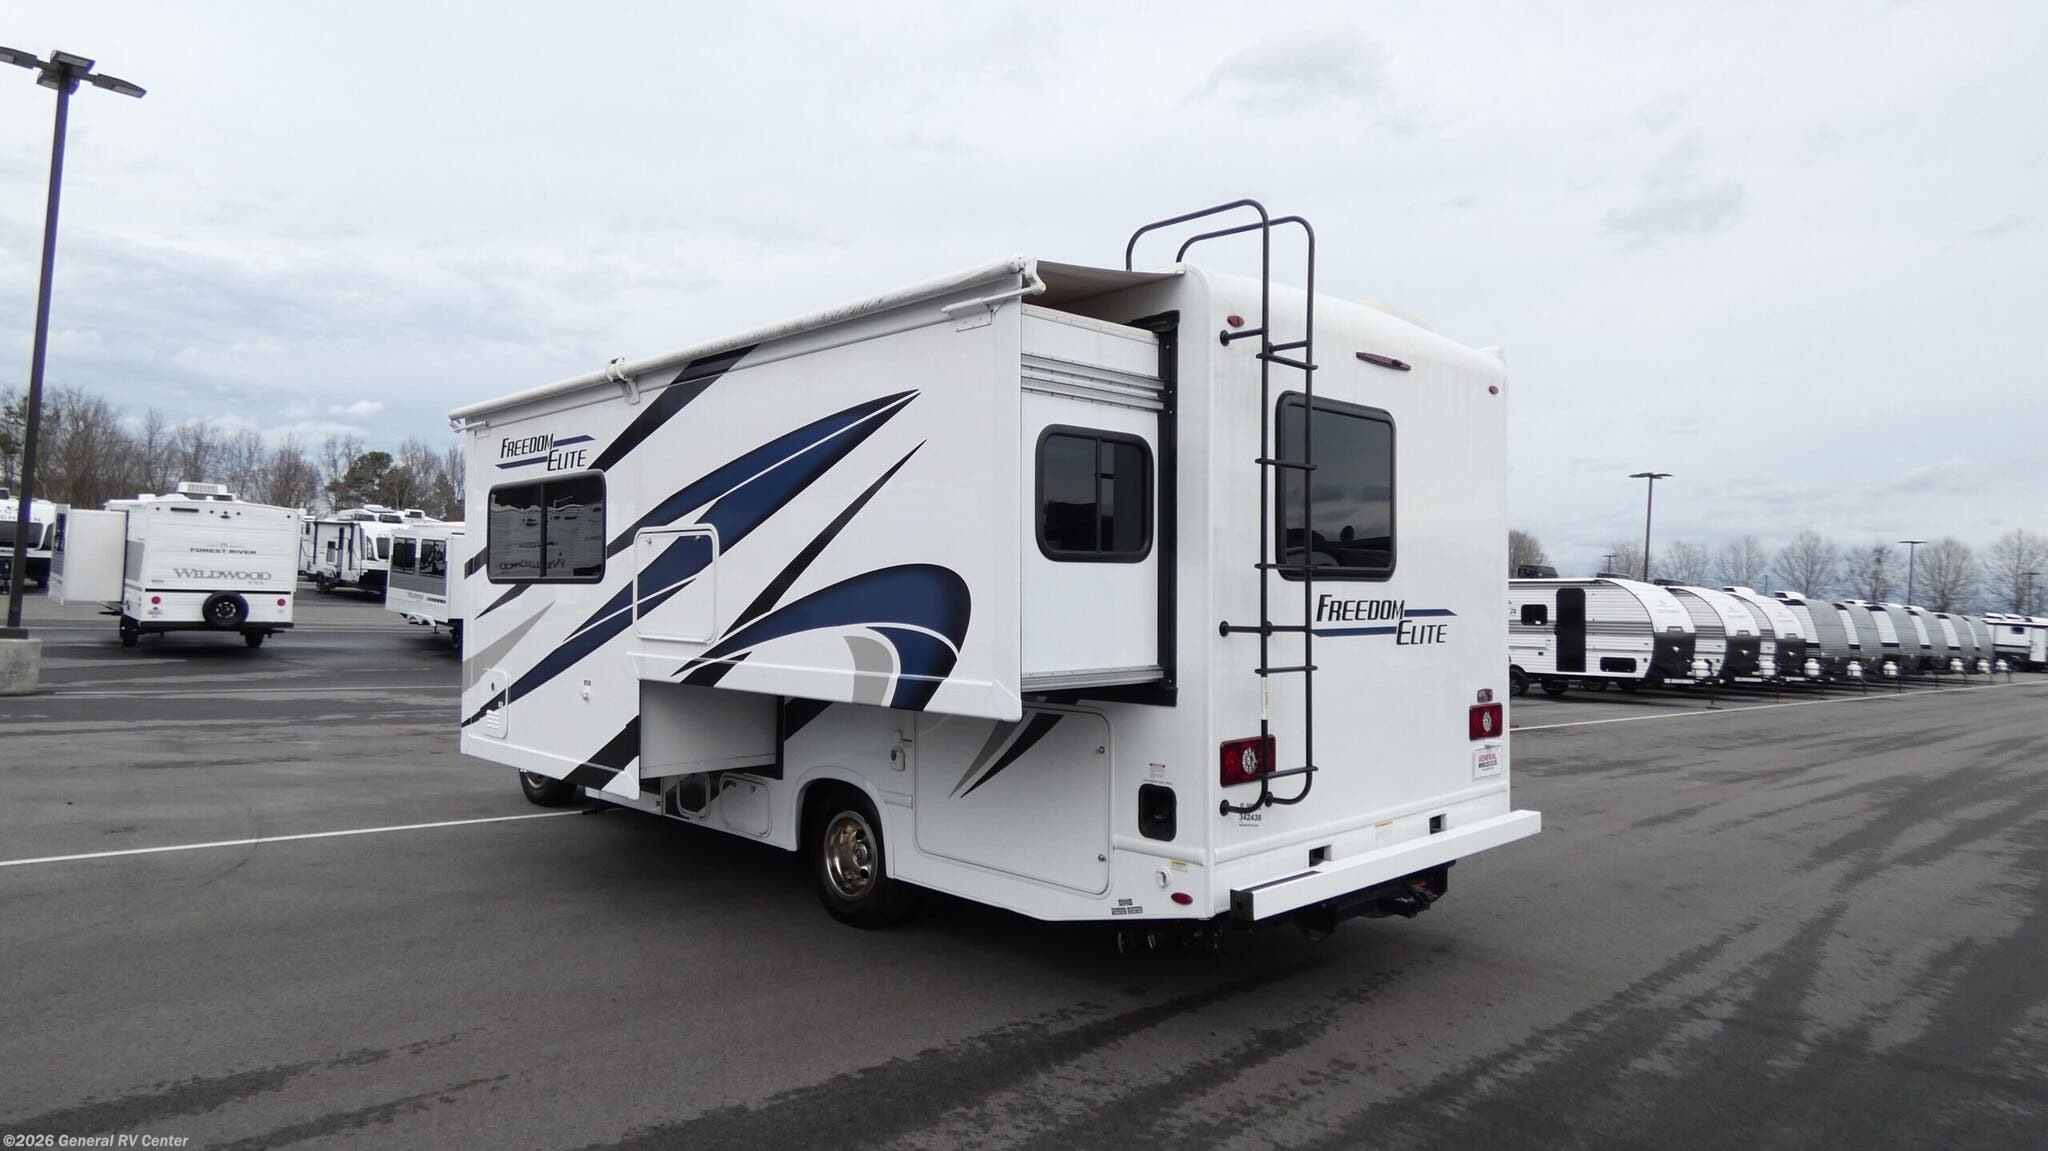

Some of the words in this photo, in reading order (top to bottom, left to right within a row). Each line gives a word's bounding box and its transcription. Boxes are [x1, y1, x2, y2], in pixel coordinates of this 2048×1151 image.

[500, 433, 554, 459] FREEDOM
[547, 449, 587, 471] ELITE
[190, 547, 227, 555] FOREST
[229, 548, 257, 556] RIVER
[172, 568, 272, 580] WILDWOOD
[1316, 594, 1405, 621] FREEDOM
[1396, 620, 1448, 645] ELITE
